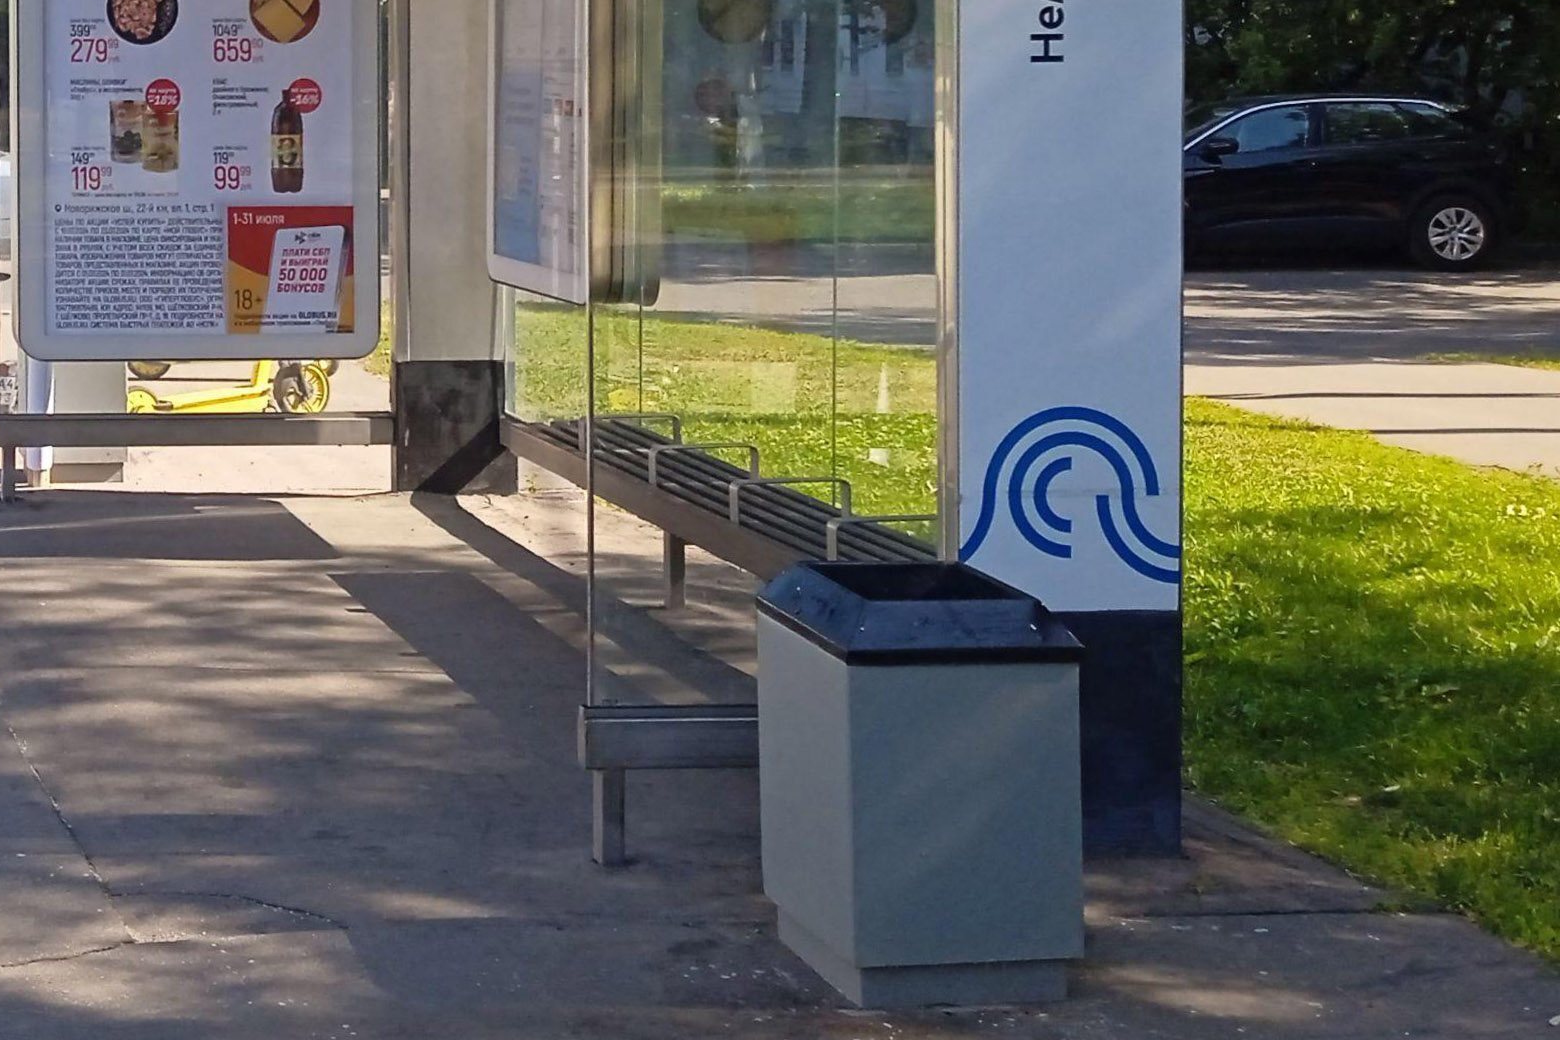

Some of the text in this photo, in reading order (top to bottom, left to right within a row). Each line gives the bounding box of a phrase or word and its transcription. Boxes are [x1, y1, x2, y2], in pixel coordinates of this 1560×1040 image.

[70, 25, 91, 37] 399
[212, 24, 239, 37] 1049
[71, 39, 107, 62] 279
[213, 39, 251, 62] 659
[71, 152, 89, 164] 149
[213, 152, 229, 164] 119
[72, 166, 100, 190] 119
[214, 166, 240, 190] 99
[233, 213, 253, 225] 1-31
[282, 248, 330, 257] ПЛАТИ СБП
[289, 258, 329, 267] ВЫИГРАЙ
[279, 268, 328, 281] 50 000
[277, 283, 326, 293] БОНУСОВ
[234, 289, 263, 310] 18+
